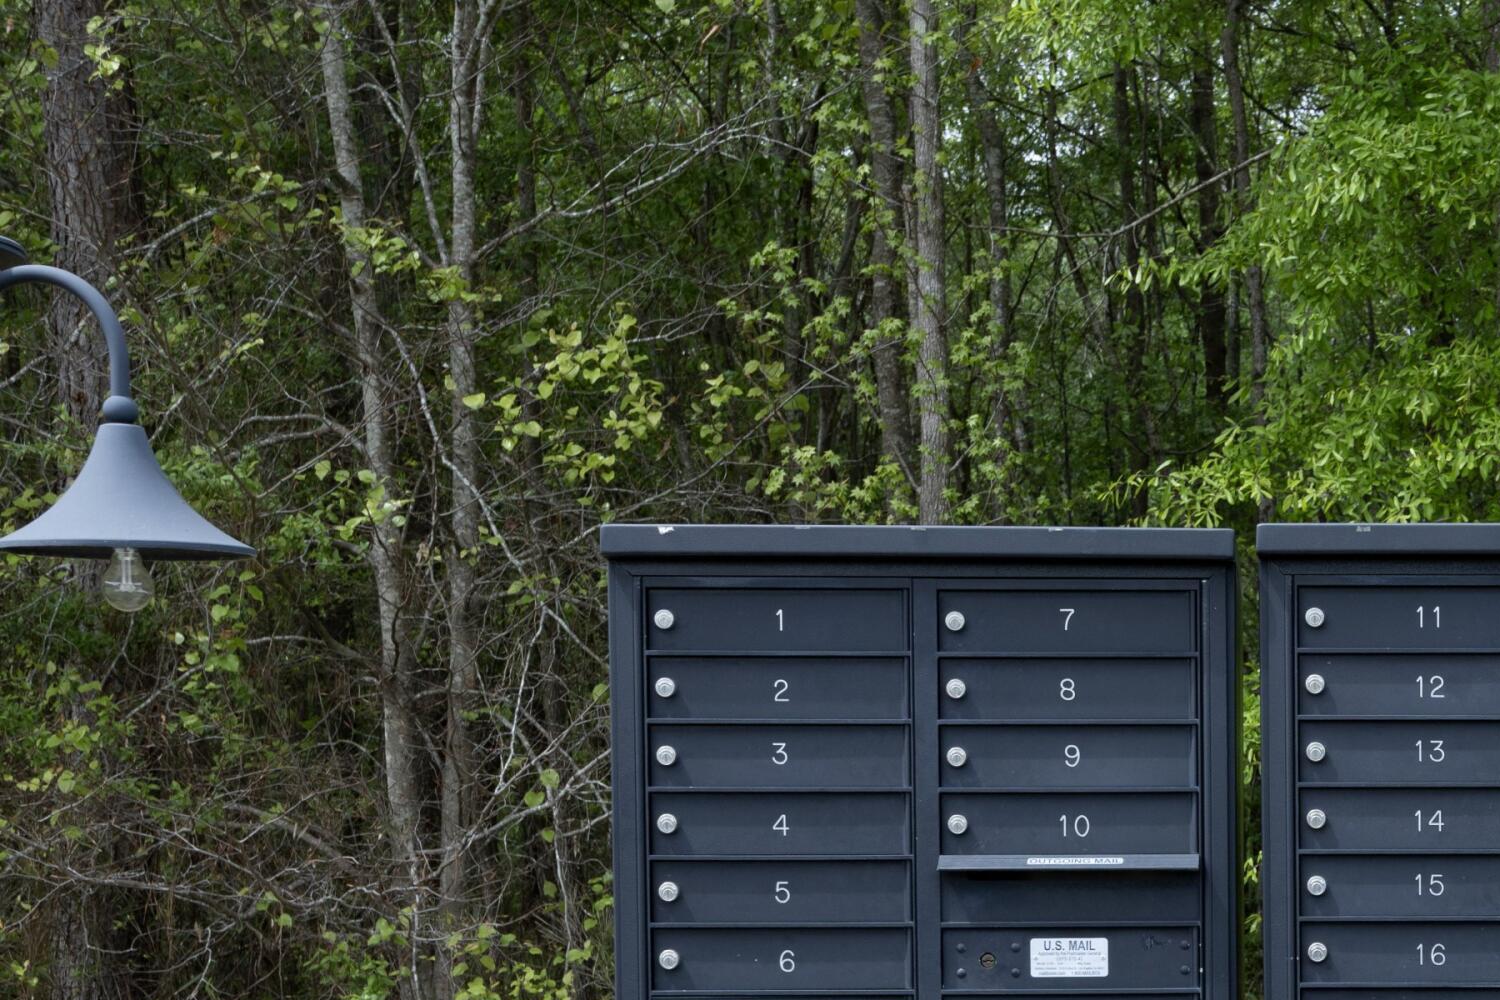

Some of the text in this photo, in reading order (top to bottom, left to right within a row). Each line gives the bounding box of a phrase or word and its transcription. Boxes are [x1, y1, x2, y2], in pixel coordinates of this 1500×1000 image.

[775, 608, 783, 632] 1
[1059, 608, 1075, 631] 7
[1416, 605, 1440, 628] 11
[773, 679, 790, 702] 2
[1059, 678, 1076, 701] 8
[1416, 675, 1445, 698] 12
[772, 742, 788, 765] 3
[1064, 744, 1081, 768] 9
[1415, 740, 1445, 763] 13
[772, 814, 790, 837] 4
[1059, 814, 1090, 838] 10
[1414, 809, 1445, 832] 14
[774, 881, 791, 904] 5
[1415, 873, 1445, 896] 15
[1043, 940, 1096, 951] U.S. MAIL
[1416, 943, 1446, 966] 16
[779, 949, 796, 973] 6
